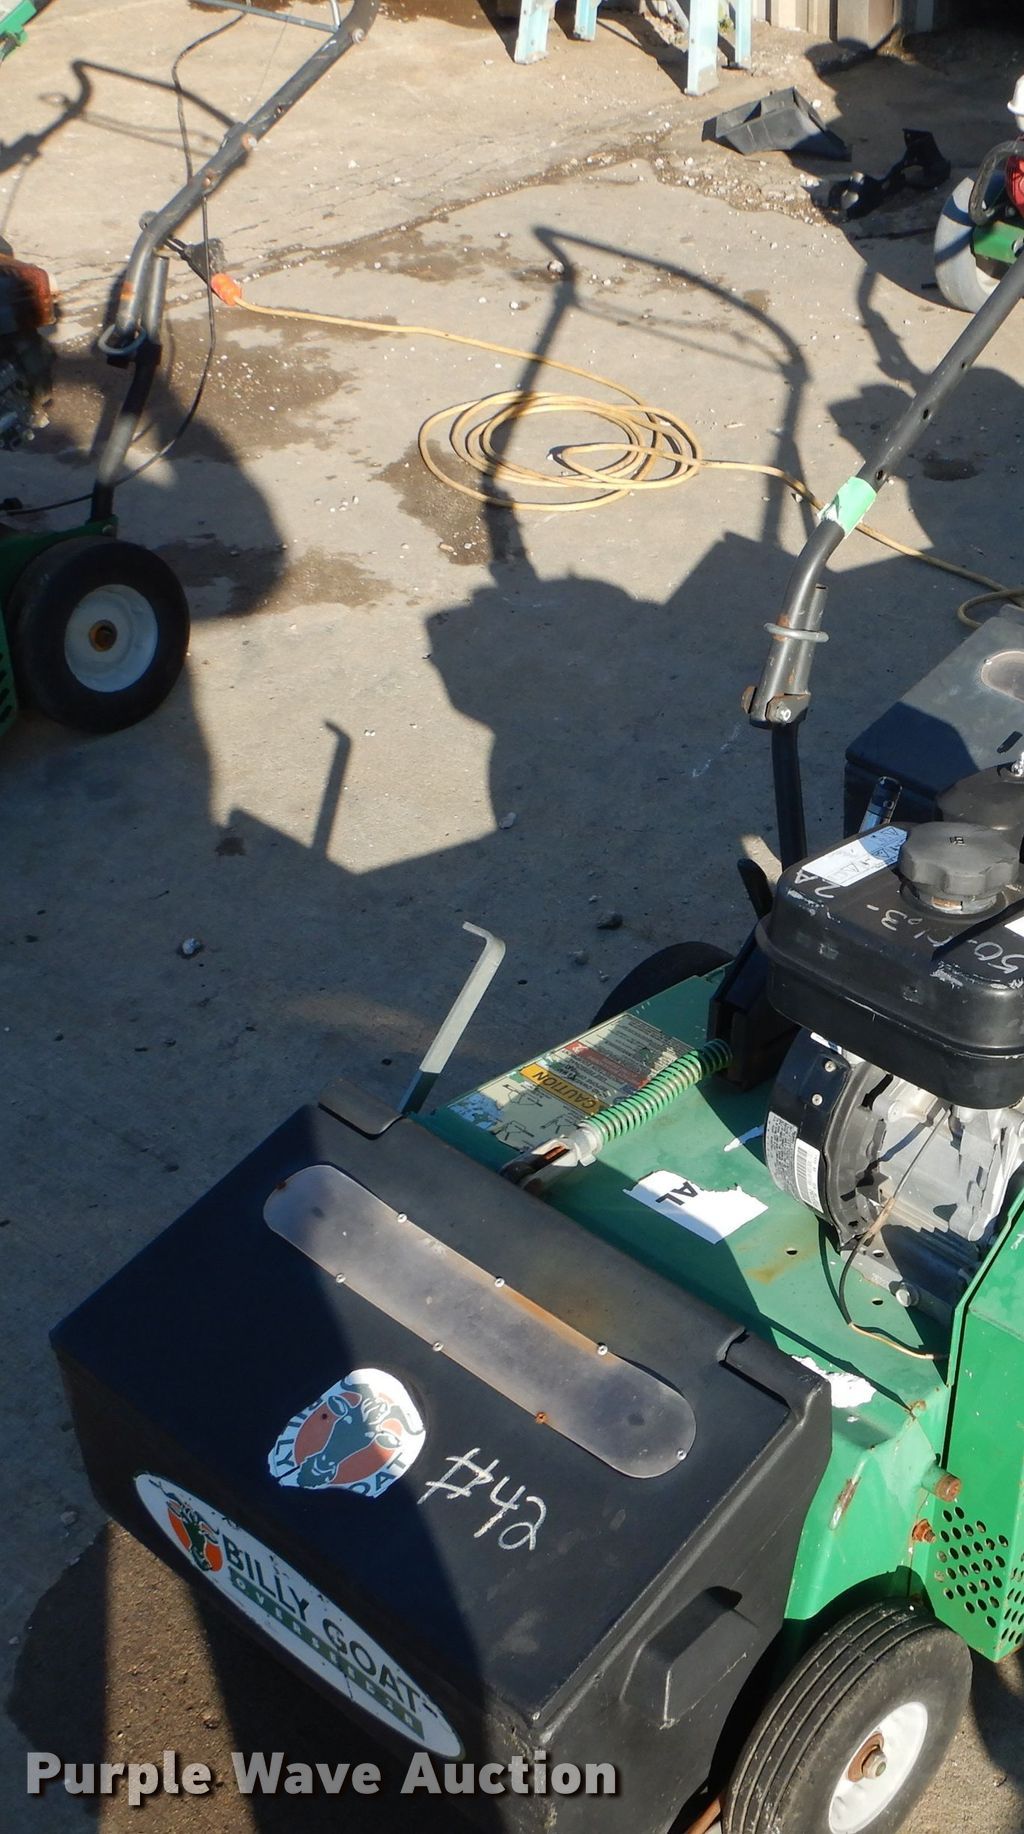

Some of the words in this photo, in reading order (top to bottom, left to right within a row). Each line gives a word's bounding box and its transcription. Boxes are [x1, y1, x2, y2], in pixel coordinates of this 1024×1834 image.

[533, 1070, 597, 1110] CAUTION
[417, 1448, 546, 1551] #42
[220, 1533, 310, 1622] BILLY
[322, 1617, 421, 1713] GOAT
